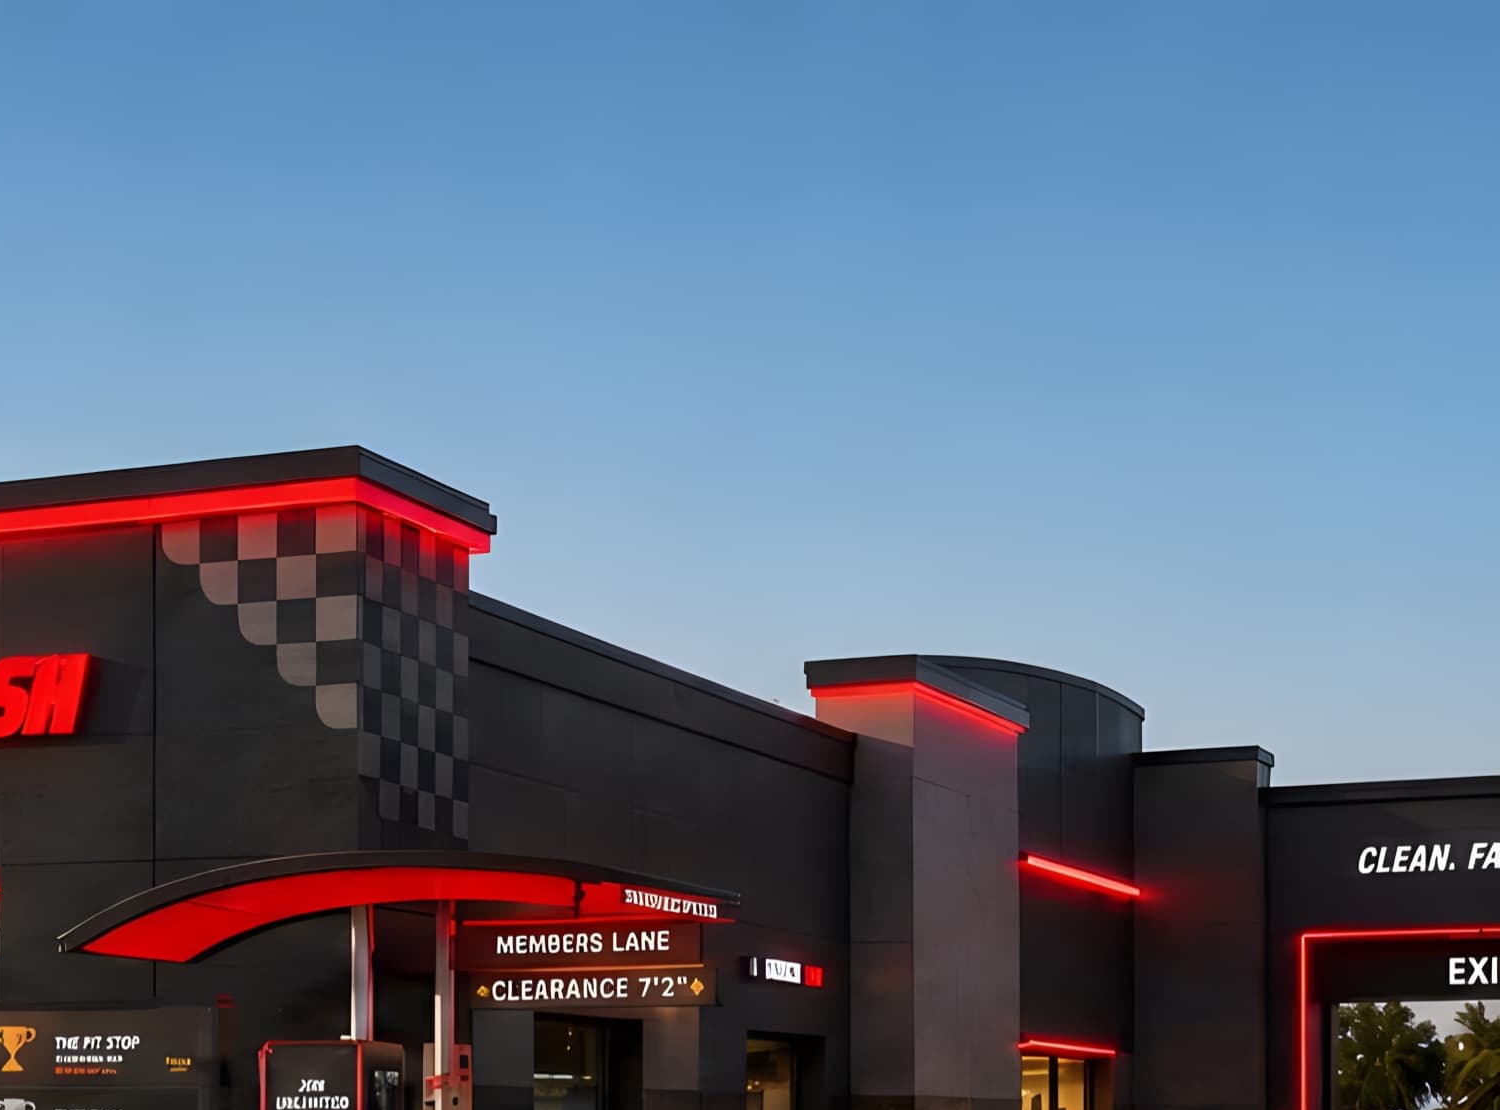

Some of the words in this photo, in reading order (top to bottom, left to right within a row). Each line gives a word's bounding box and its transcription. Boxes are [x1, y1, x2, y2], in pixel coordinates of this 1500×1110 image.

[1357, 843, 1456, 875] CLEAN.
[495, 932, 604, 955] MEMBERS
[611, 929, 671, 953] LANE
[491, 977, 630, 1002] CLEARANCE
[638, 975, 689, 999] 7'2"
[106, 1035, 140, 1050] STOP
